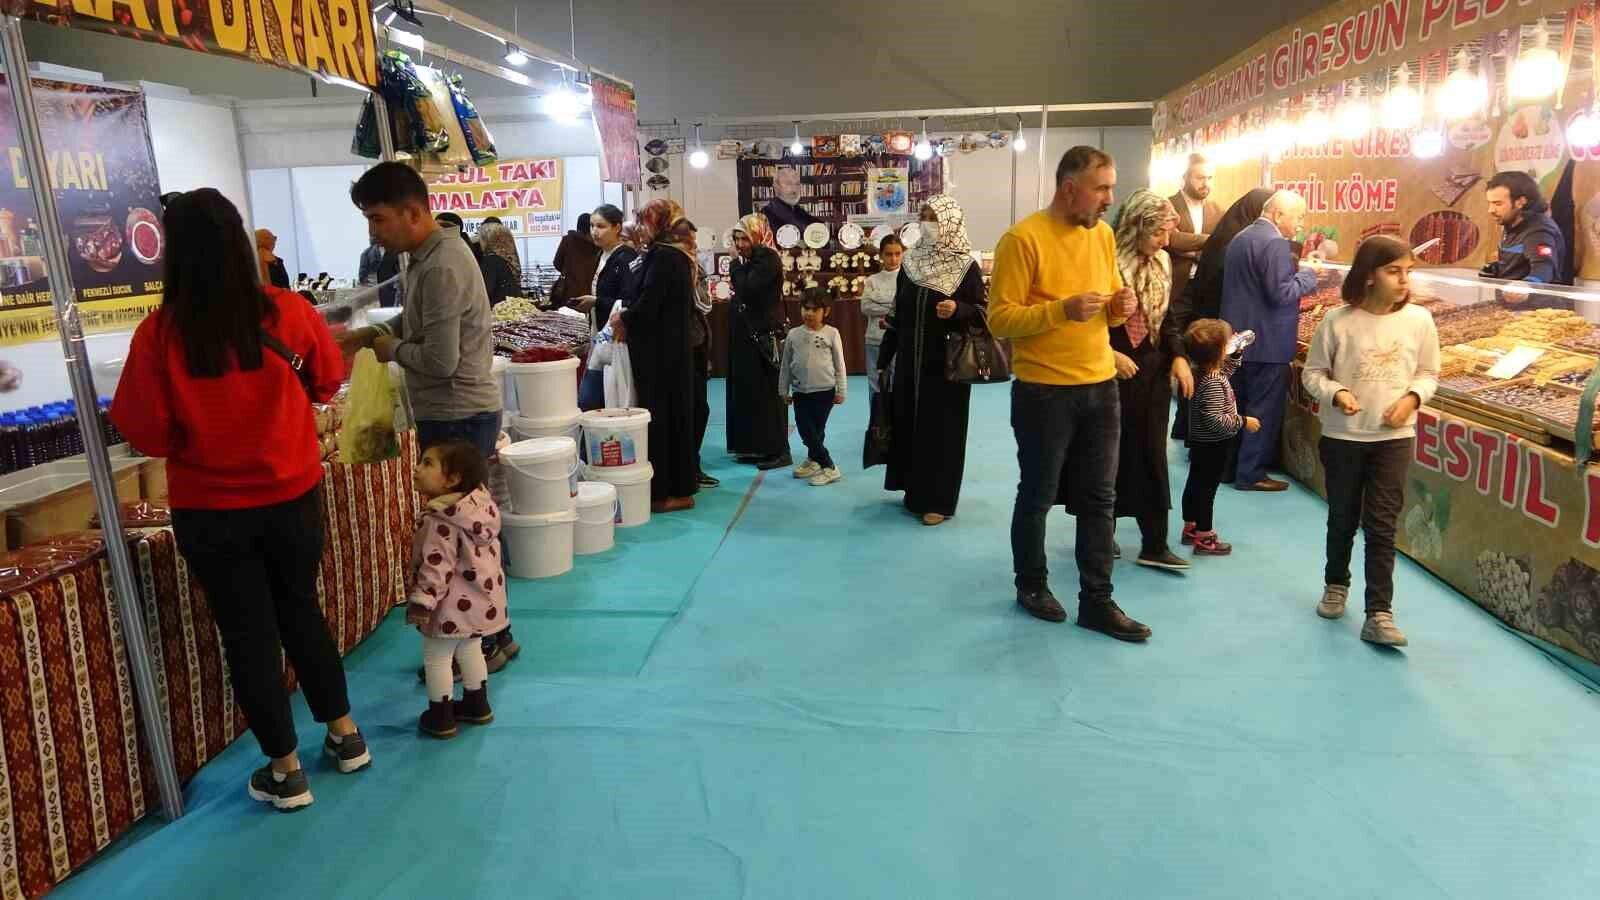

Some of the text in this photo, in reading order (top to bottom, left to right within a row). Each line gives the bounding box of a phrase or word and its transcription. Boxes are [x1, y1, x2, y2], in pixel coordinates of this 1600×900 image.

[1272, 0, 1410, 89] GİRESUN
[498, 160, 557, 182] TAKI
[429, 188, 546, 212] MALATYA
[1334, 173, 1398, 213] KÖME
[1415, 410, 1560, 528] ESTİL
